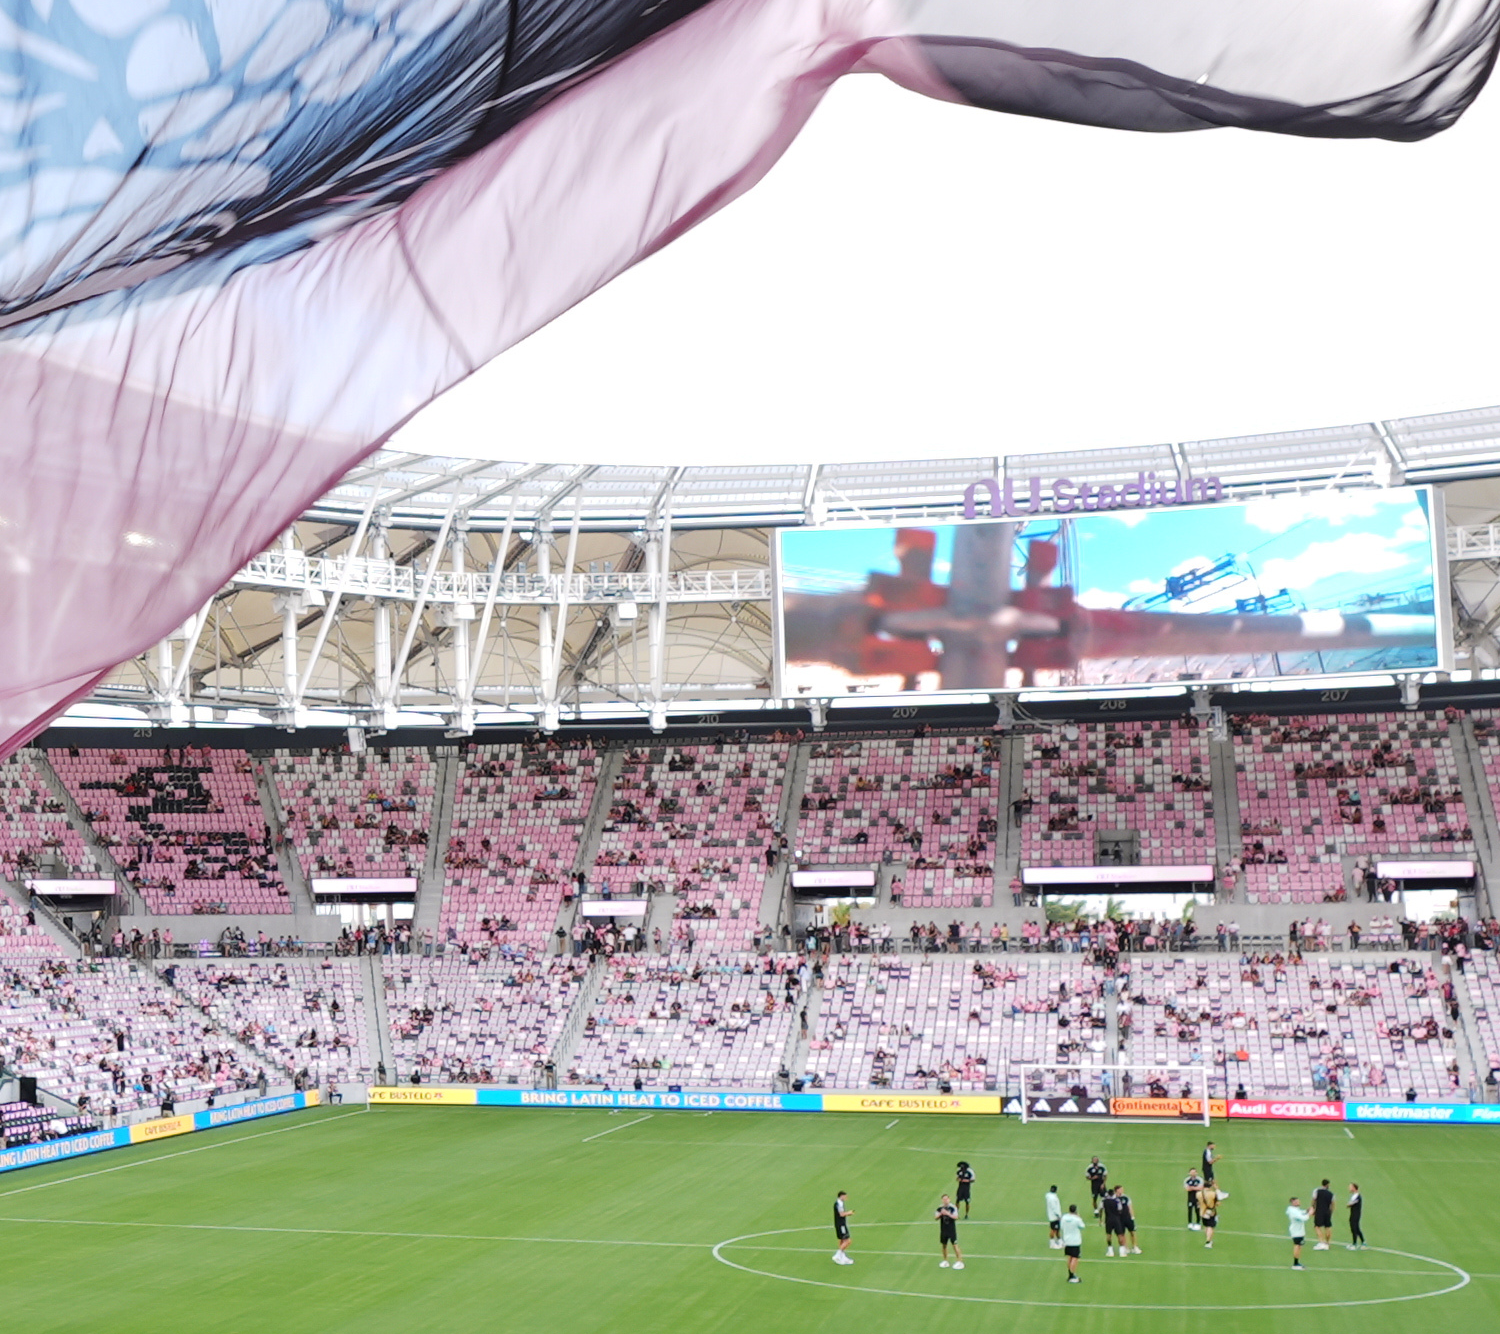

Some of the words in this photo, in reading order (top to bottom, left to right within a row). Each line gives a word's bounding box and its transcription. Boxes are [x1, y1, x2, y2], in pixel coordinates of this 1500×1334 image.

[1053, 471, 1223, 515] Stadium
[1320, 690, 1348, 702] 207
[1098, 700, 1126, 710] 208
[892, 708, 919, 718] 209
[132, 727, 153, 738] 213
[520, 1092, 566, 1105] BRING
[571, 1092, 613, 1105] LATIN
[617, 1092, 655, 1106] HEAT
[657, 1093, 680, 1106] TO
[683, 1093, 719, 1107] ICED
[723, 1094, 784, 1108] COFFEE
[1112, 1098, 1180, 1115] Continental
[1230, 1103, 1267, 1115] Audi
[1356, 1103, 1454, 1120] ticketmaster
